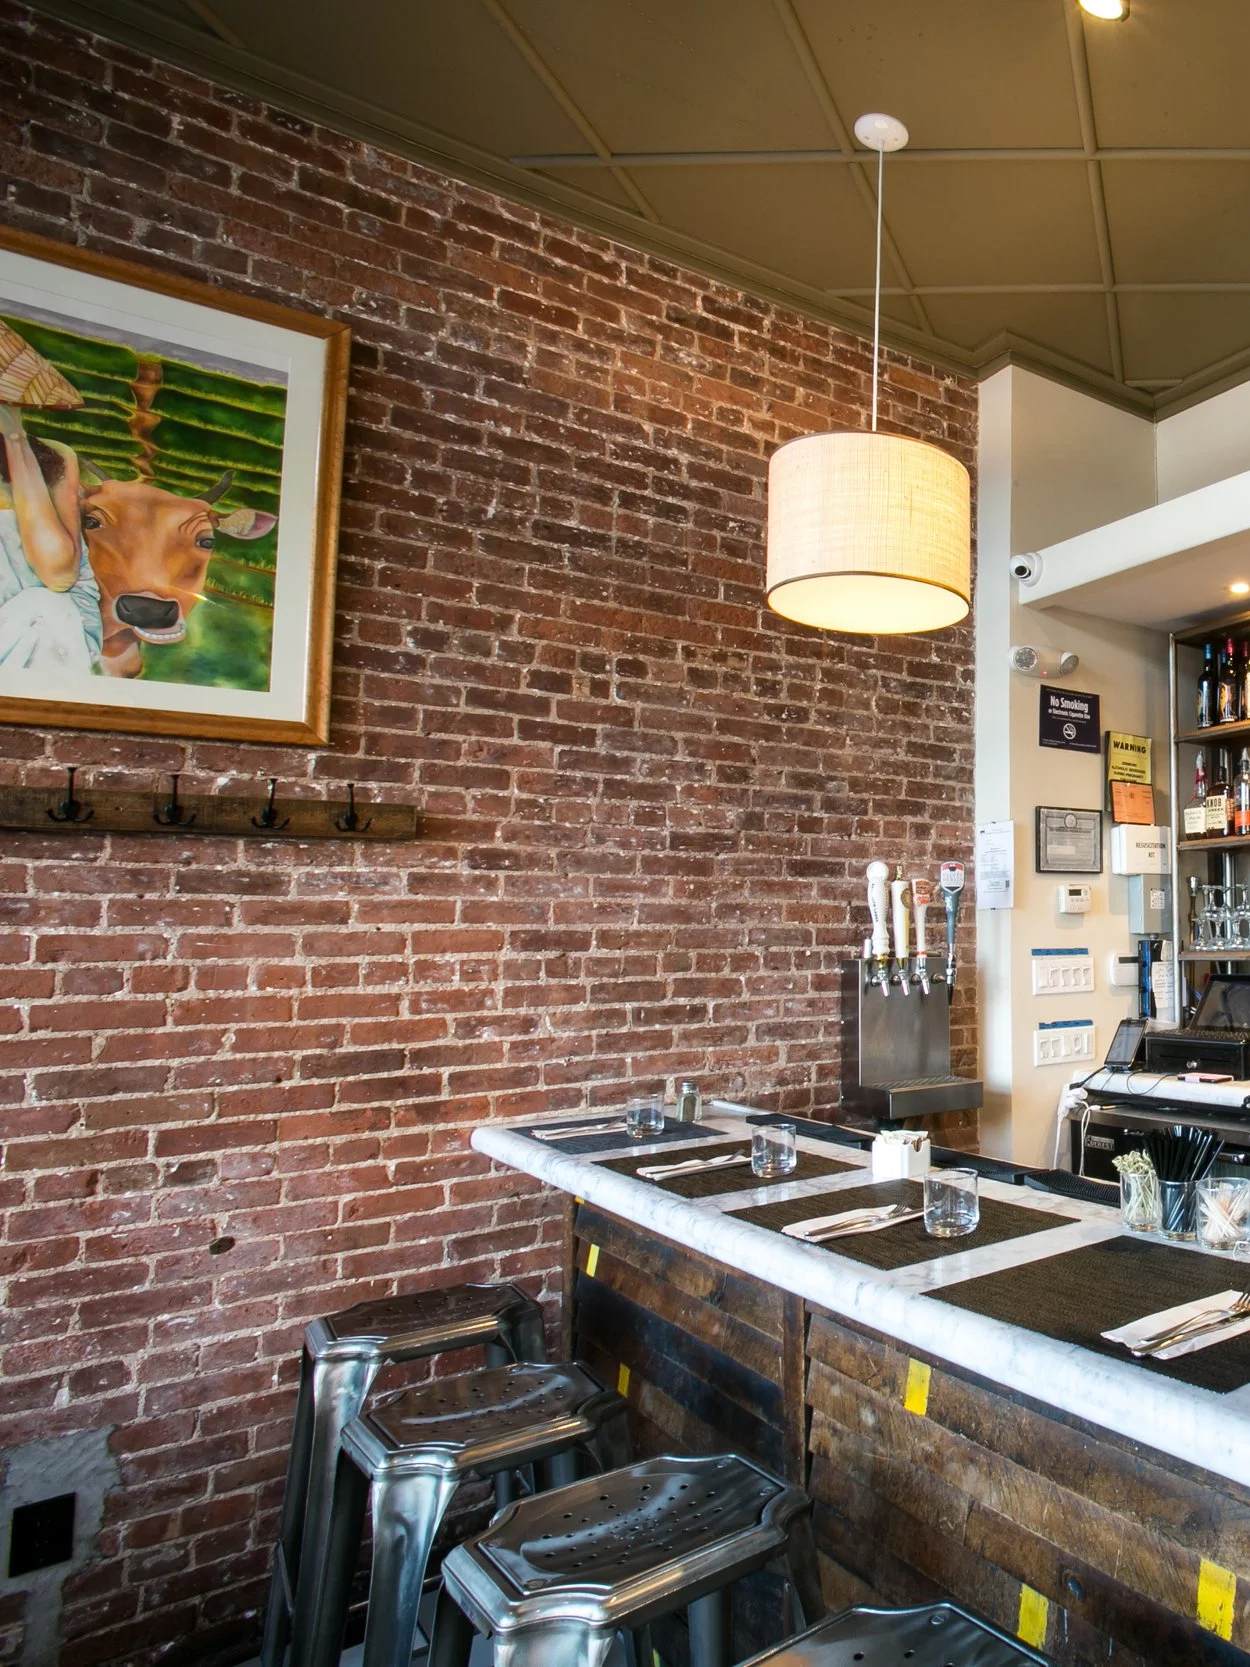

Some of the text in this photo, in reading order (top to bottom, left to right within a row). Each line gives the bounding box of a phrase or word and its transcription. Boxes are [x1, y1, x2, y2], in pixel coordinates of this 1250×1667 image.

[1050, 695, 1089, 714] No Smoking
[1113, 740, 1147, 754] WARNING
[1135, 842, 1167, 850] RESUSCITATION
